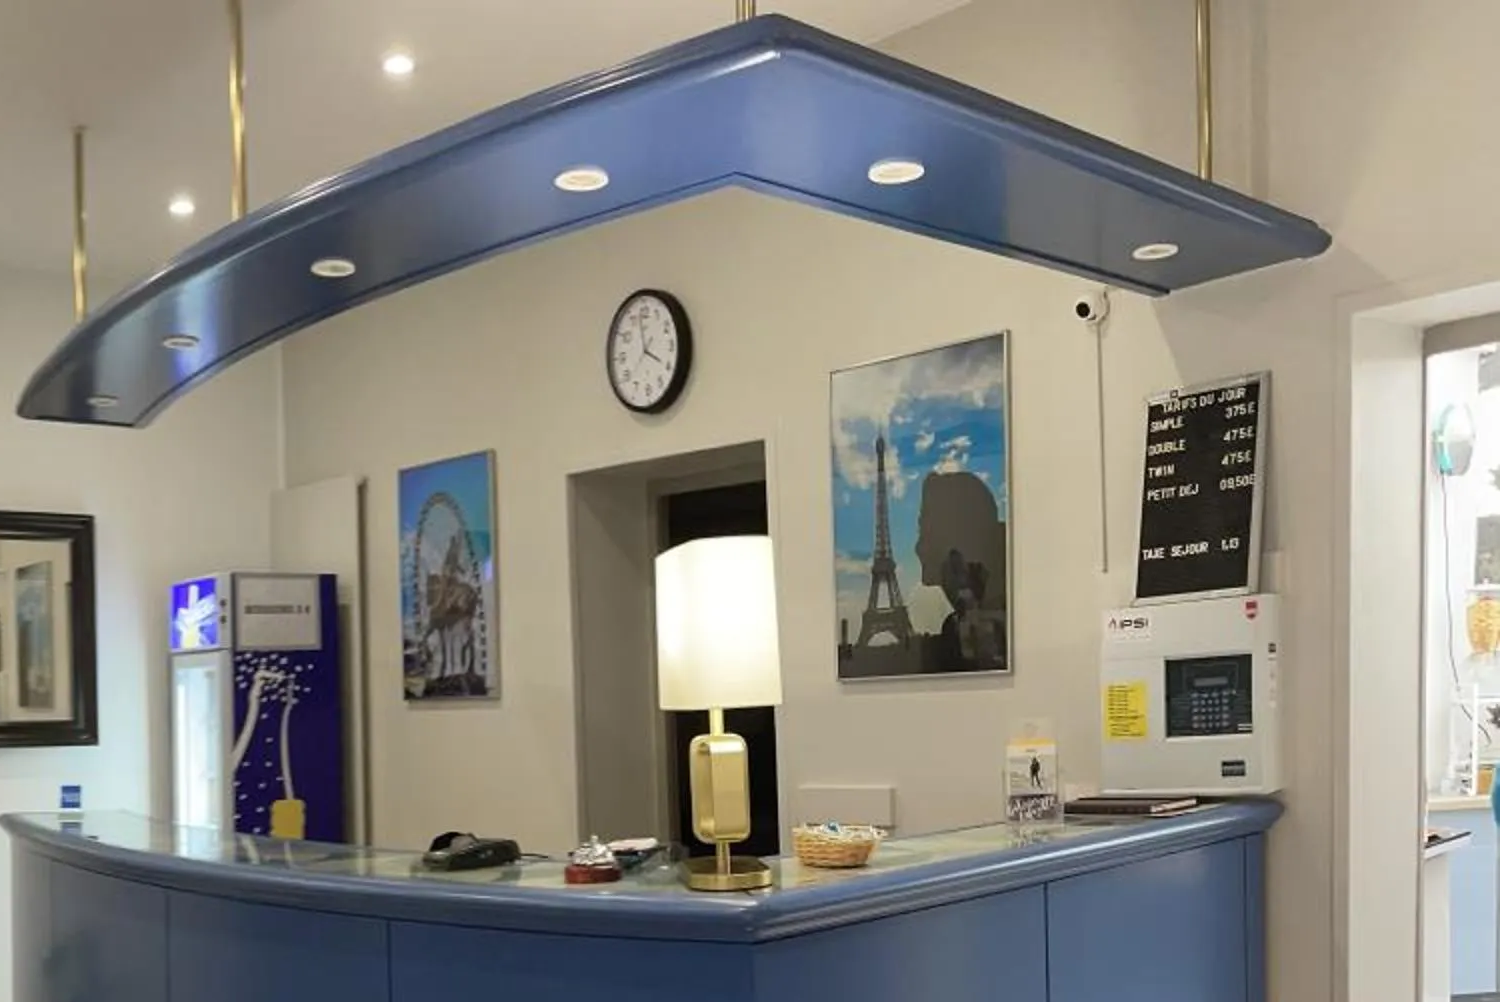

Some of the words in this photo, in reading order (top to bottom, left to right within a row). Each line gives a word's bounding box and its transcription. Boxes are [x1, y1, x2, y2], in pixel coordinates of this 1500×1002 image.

[1200, 392, 1215, 407] DU
[1148, 464, 1175, 479] TWIN
[1147, 486, 1176, 501] PETIT
[1171, 541, 1209, 557] SEJOUR
